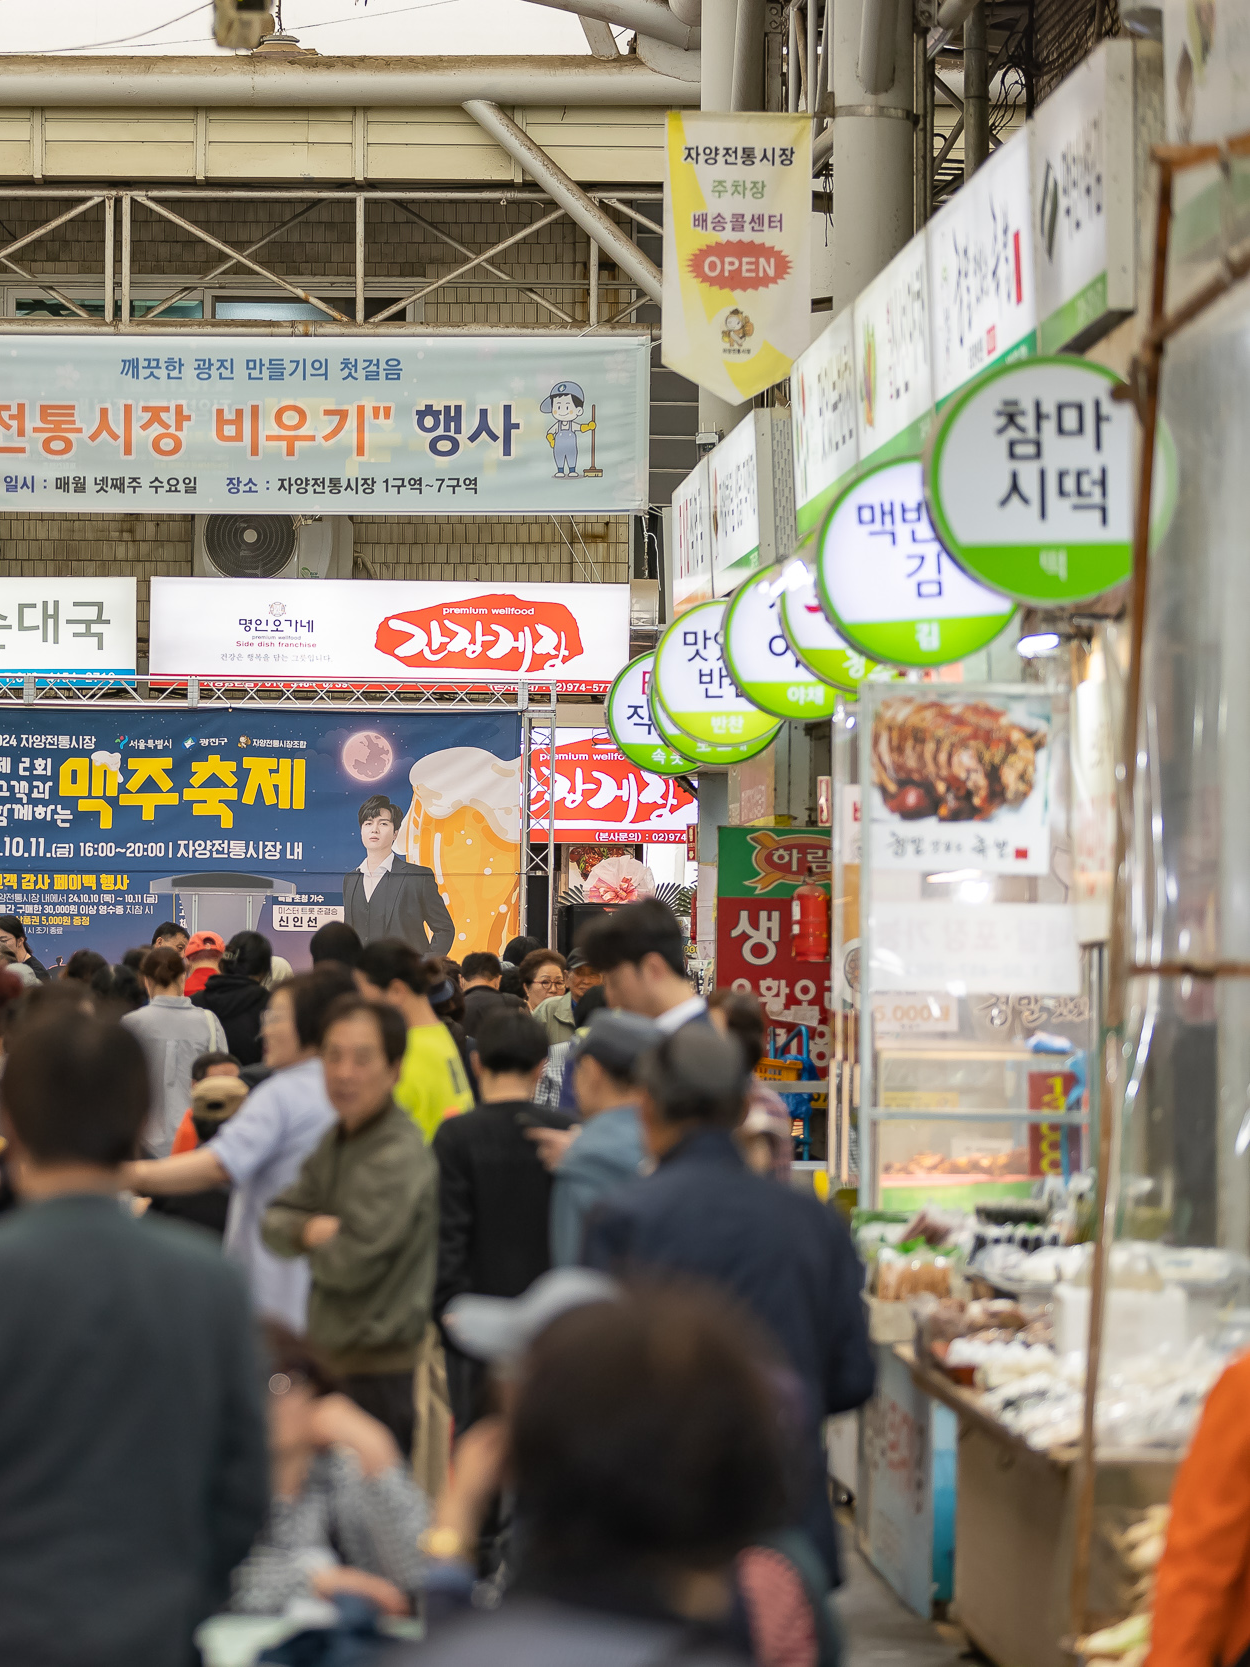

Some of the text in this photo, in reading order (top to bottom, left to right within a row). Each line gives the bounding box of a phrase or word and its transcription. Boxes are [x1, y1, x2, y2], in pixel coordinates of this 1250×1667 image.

[683, 145, 795, 166] 자양전통시장
[711, 180, 766, 199] 주차장
[693, 212, 783, 232] 배송콜센터
[704, 256, 775, 277] OPEN
[120, 357, 403, 381] 깨끗한 광진 만들기의 첫걸음
[215, 404, 392, 457] 비우기"
[415, 404, 520, 457] 행사
[993, 397, 1112, 460] 참마
[4, 475, 35, 493] 일시
[55, 475, 87, 493] 매월
[94, 475, 142, 494] 넷째주
[149, 476, 197, 494] 수요일
[226, 476, 258, 494] 장소
[277, 476, 377, 494] 자양전통시장
[382, 477, 478, 495] 1구역~7구역
[998, 466, 1108, 528] 시떡
[443, 606, 535, 616] premium wellfood
[238, 618, 314, 633] 명인오가네
[387, 618, 569, 672] 간장게장
[711, 715, 744, 733] 반찬
[20, 735, 96, 750] 자양전통시장
[128, 738, 172, 749] 서울특별시
[199, 737, 228, 747] 광진구
[252, 738, 307, 749] 자양전통시장조합
[595, 832, 642, 842] (본사문의)
[79, 842, 165, 858] 16:00~20:00
[176, 840, 282, 860] 자양전통시장
[286, 841, 303, 860] 내
[21, 874, 50, 890] 감사
[53, 874, 97, 890] 페이백
[100, 874, 130, 890] 행사
[41, 893, 67, 903] 내에서
[68, 894, 99, 903] 24.10.10
[100, 894, 115, 904] (목)
[125, 894, 142, 903] 10.11
[143, 894, 158, 904] (금)
[310, 894, 324, 902] 가수
[16, 904, 42, 914] 구매한
[43, 904, 78, 915] 30,000원
[80, 904, 97, 914] 이상
[98, 904, 123, 914] 영수증
[125, 905, 143, 914] 지참
[144, 905, 153, 914] 시
[279, 906, 338, 915] 미스터 트롯 준결승
[41, 916, 71, 926] 5,000원
[73, 916, 90, 925] 증정
